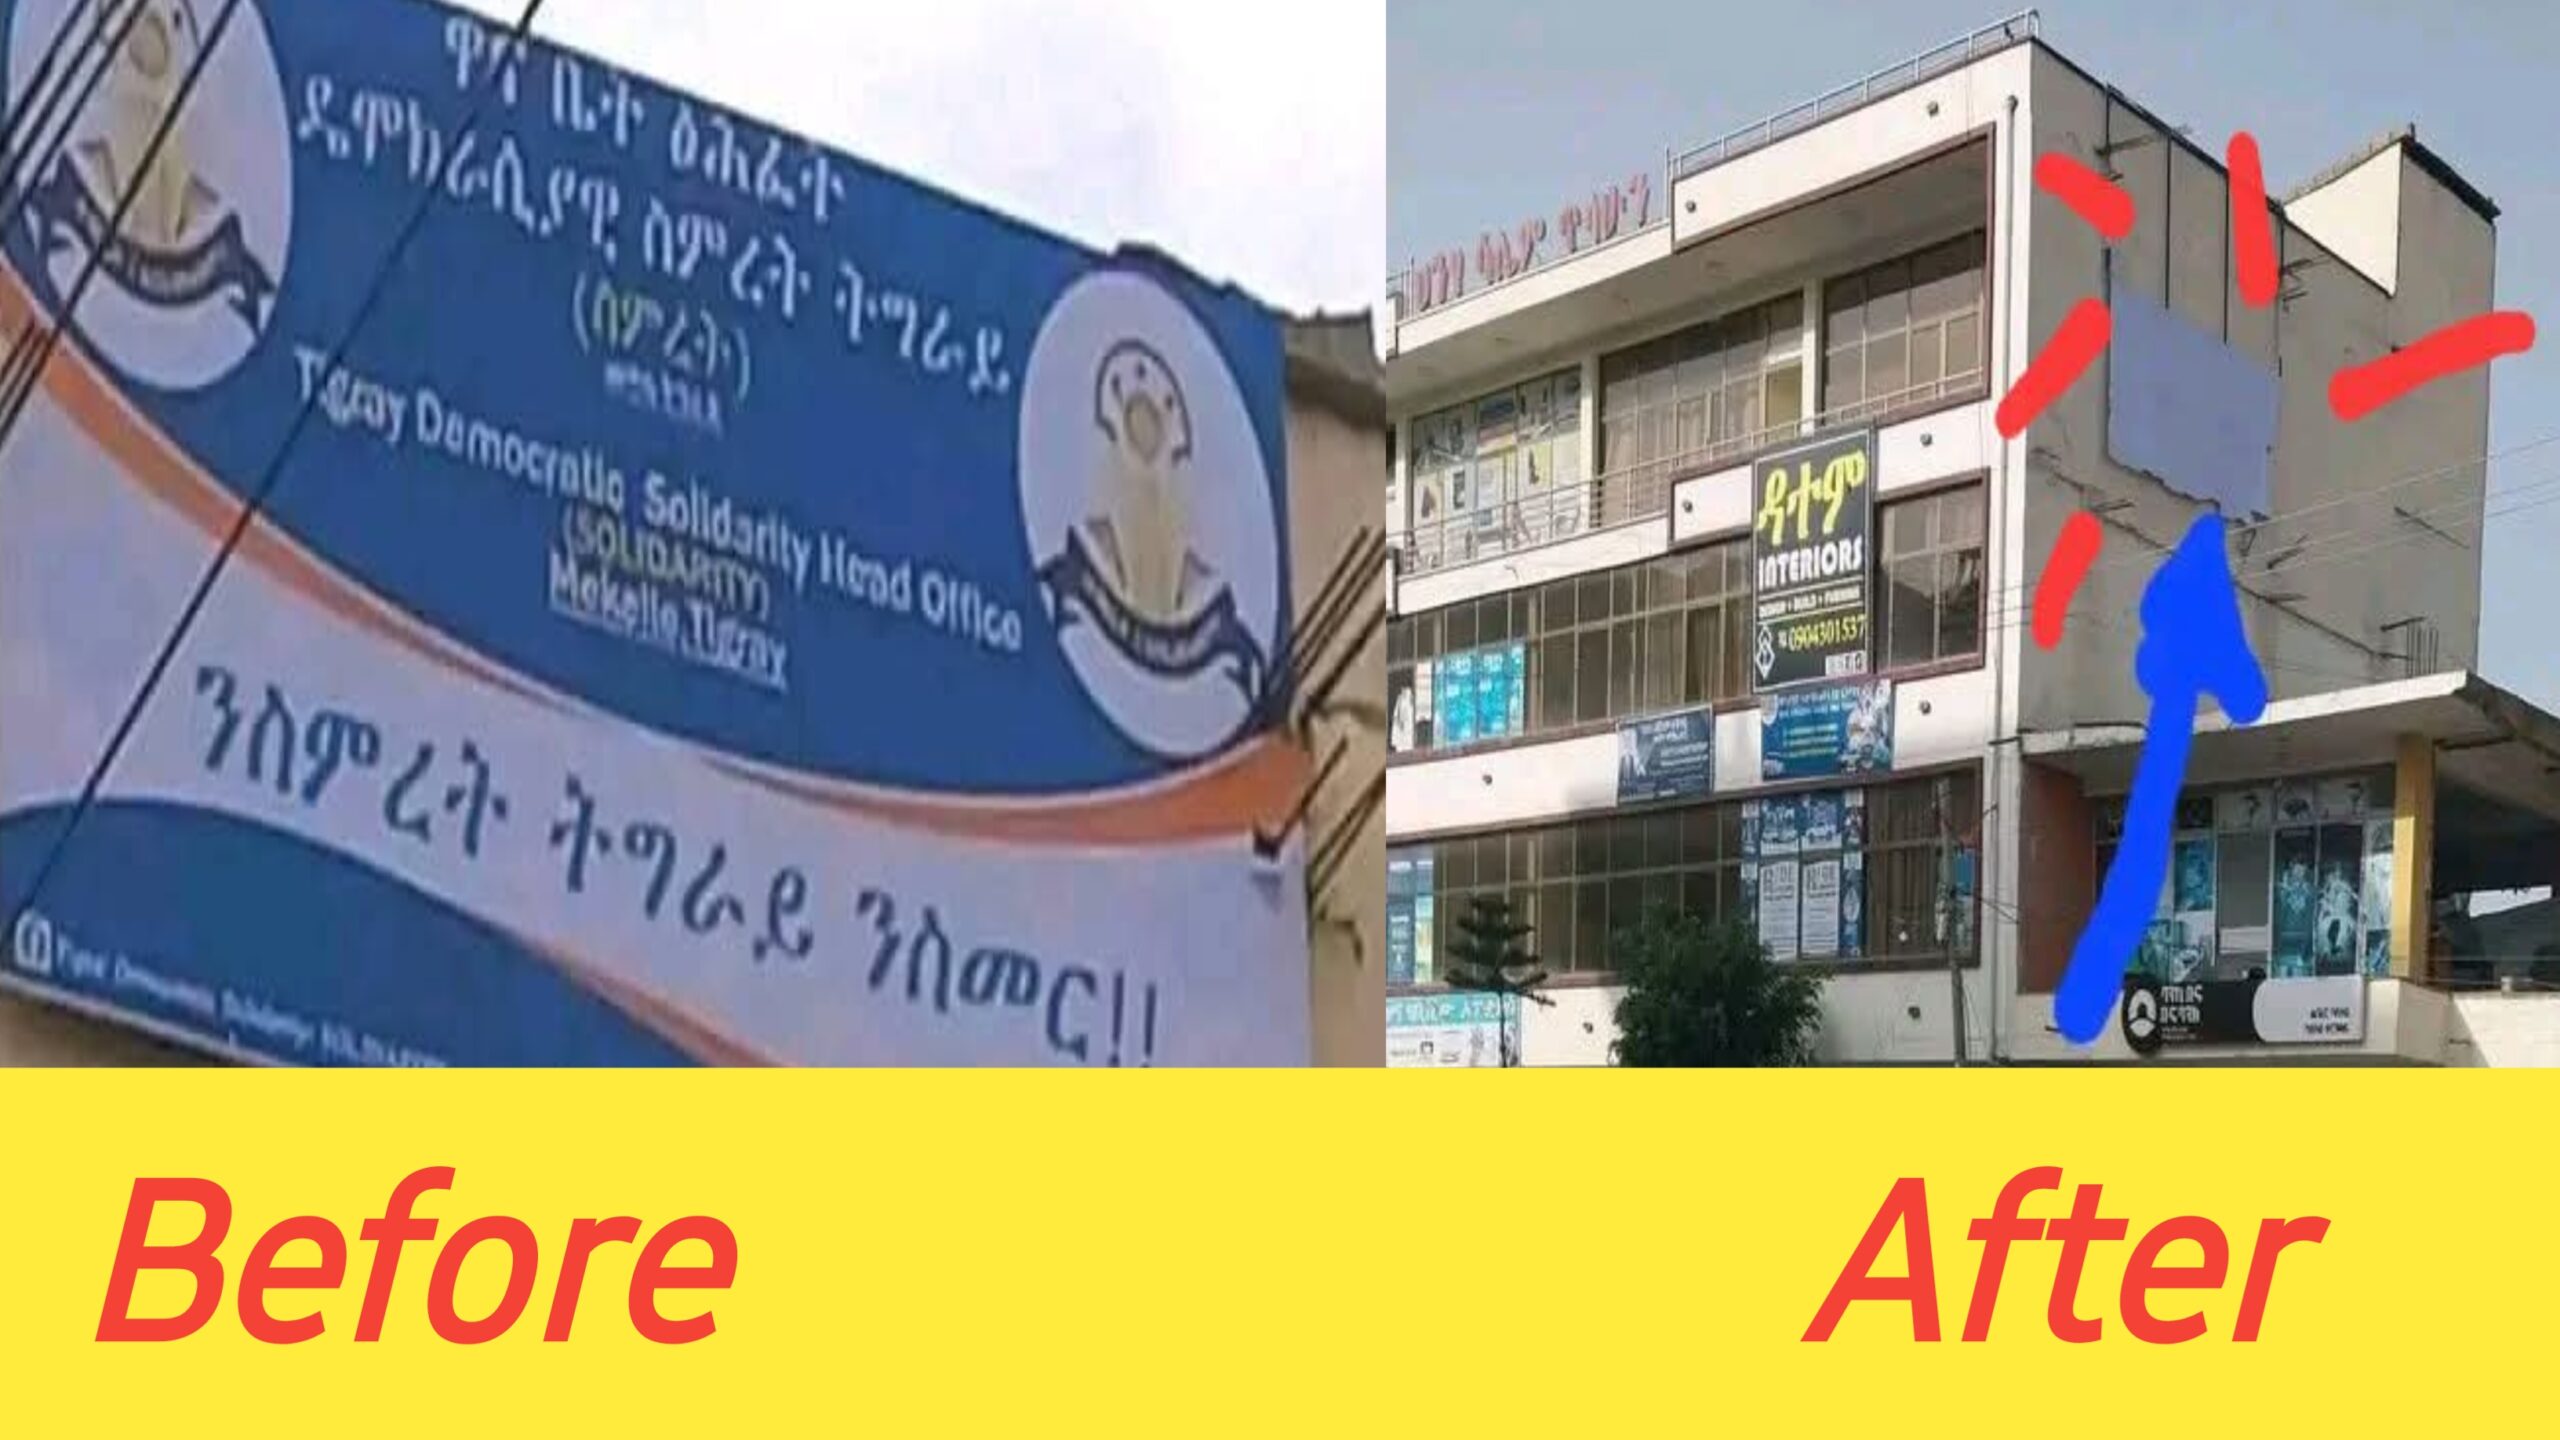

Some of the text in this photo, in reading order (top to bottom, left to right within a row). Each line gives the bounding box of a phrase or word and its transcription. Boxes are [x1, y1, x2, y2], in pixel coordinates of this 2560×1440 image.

[834, 257, 1010, 395] ትግራይ
[416, 387, 624, 514] Democratic
[645, 472, 810, 593] Solidarity
[820, 532, 910, 611] Head
[922, 567, 1022, 651] Office
[1758, 535, 1862, 591] INTERIORS
[197, 665, 507, 859] ንስምረት
[549, 773, 814, 962] ትግራይ
